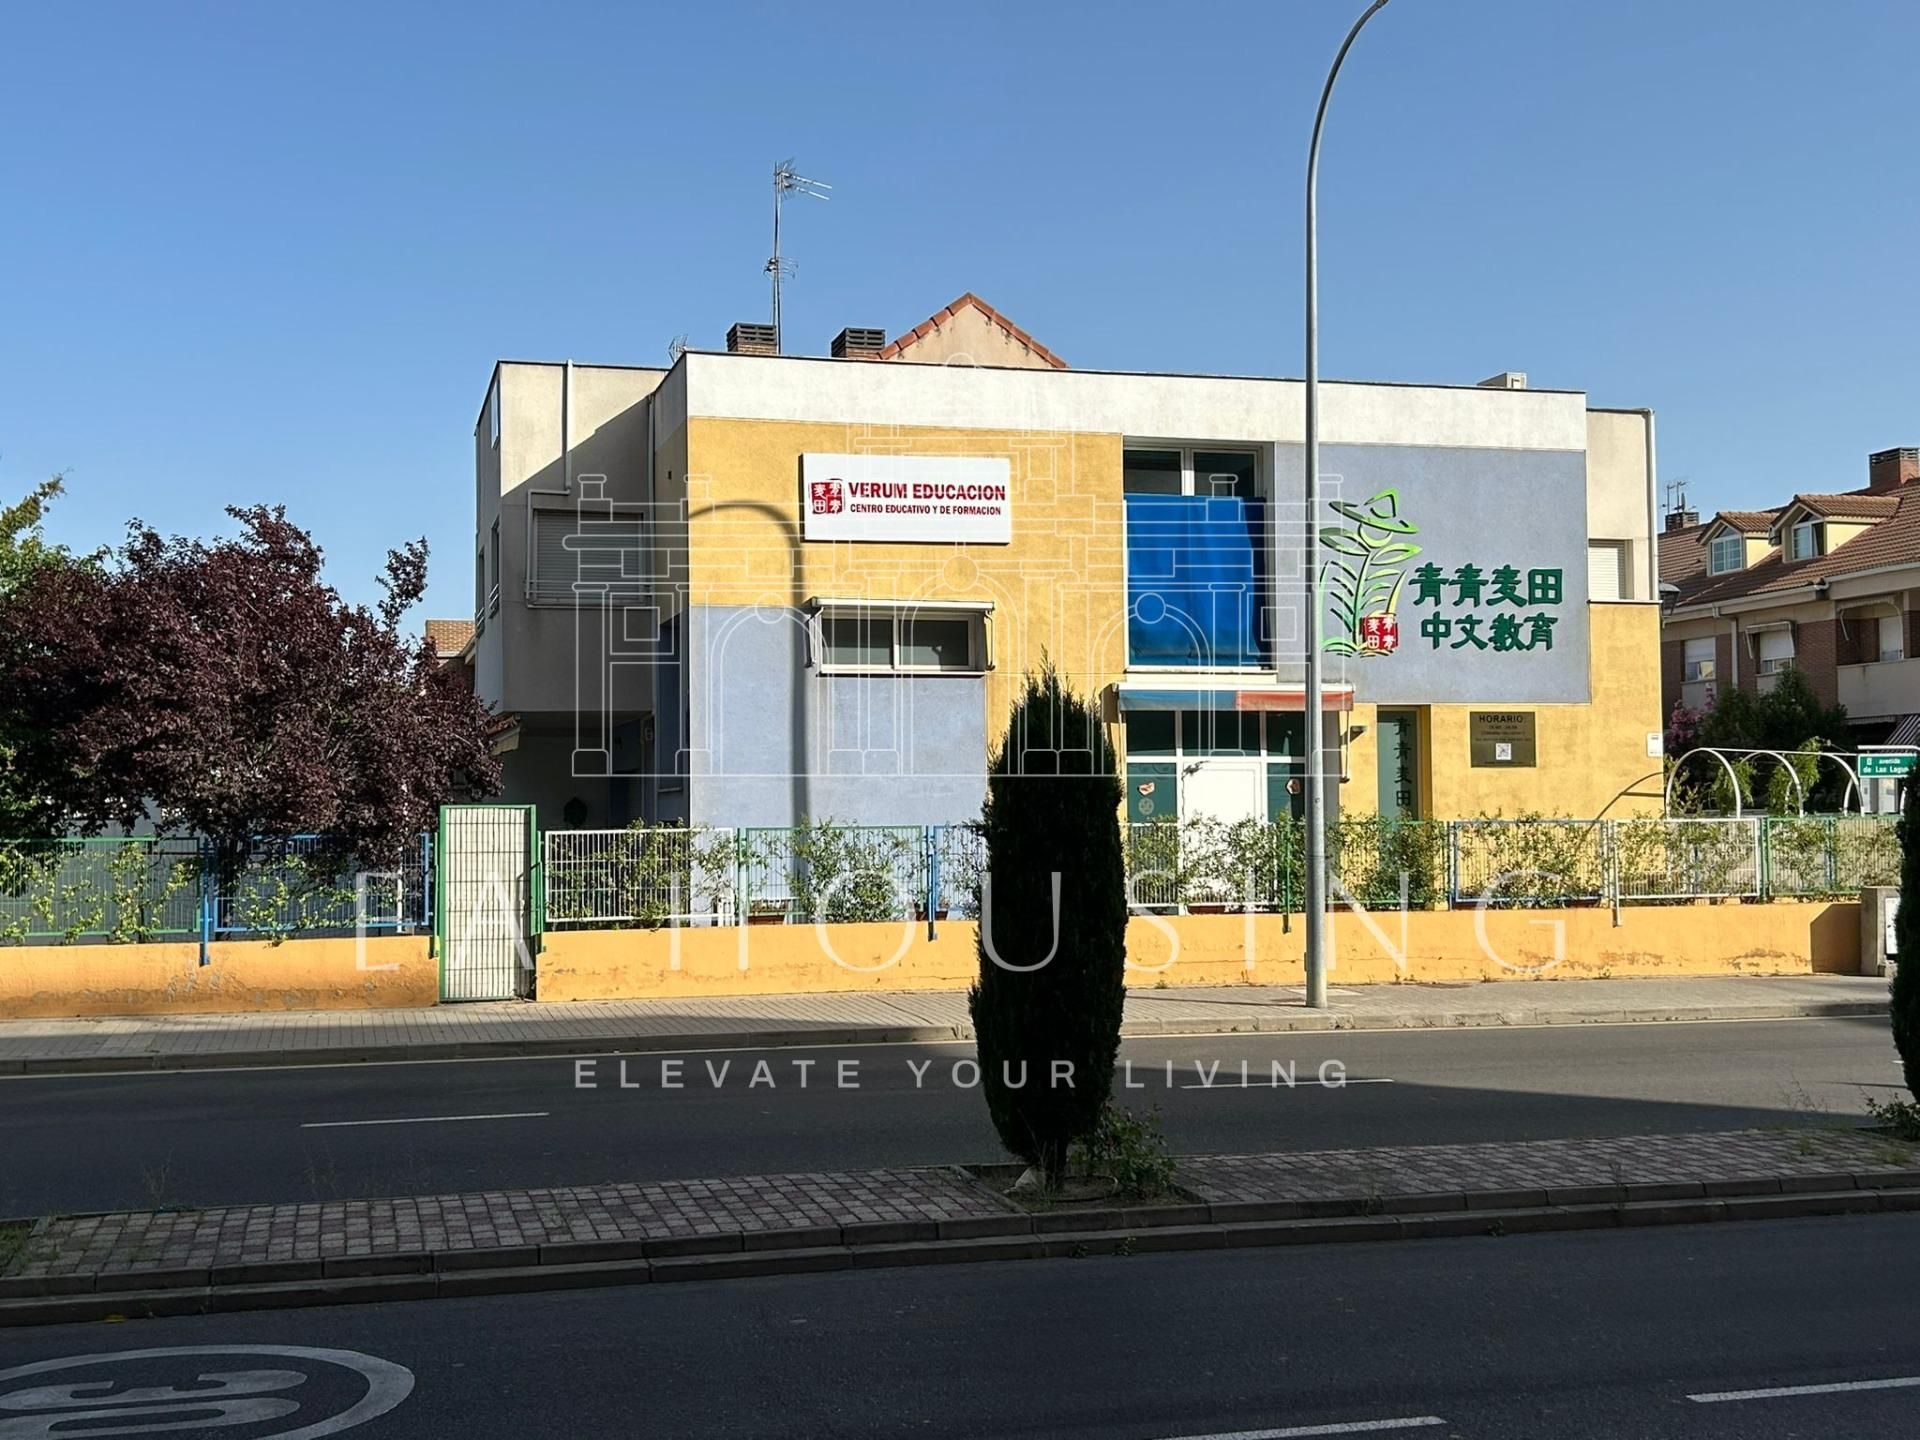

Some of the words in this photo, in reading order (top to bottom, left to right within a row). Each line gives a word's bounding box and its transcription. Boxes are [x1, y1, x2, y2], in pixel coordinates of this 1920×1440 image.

[848, 482, 908, 499] VERUM
[912, 484, 1006, 501] EDUCACION
[850, 503, 883, 513] CENTRO
[885, 504, 931, 515] EDUCATIVO
[932, 504, 938, 514] Y
[940, 505, 951, 515] DE
[952, 505, 1001, 515] FORMACION
[1408, 561, 1563, 608] 青青麦田
[1421, 610, 1559, 652] 中文教育
[1479, 714, 1523, 723] HORARIO
